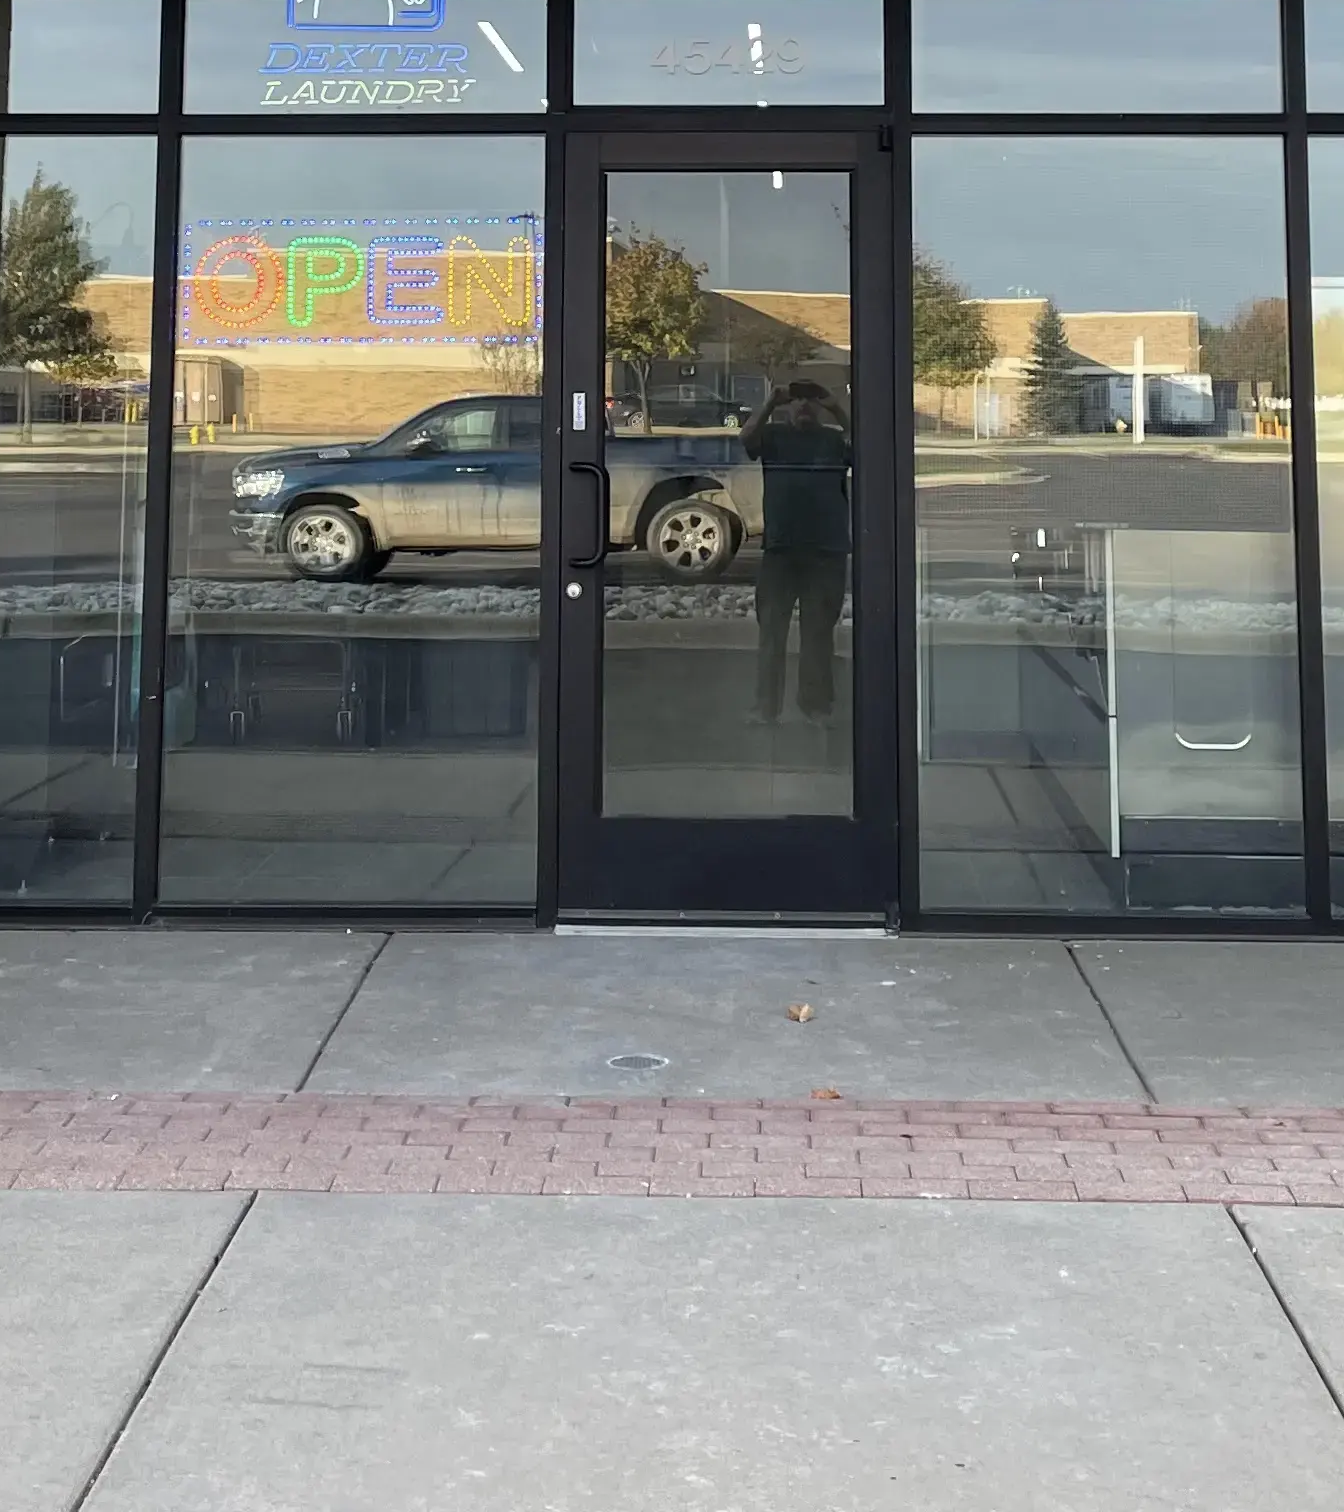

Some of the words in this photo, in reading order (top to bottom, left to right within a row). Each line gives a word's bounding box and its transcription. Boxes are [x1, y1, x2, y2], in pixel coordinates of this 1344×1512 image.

[258, 41, 469, 74] DEXTER
[260, 79, 477, 105] LAUNDRY
[193, 235, 533, 328] OPEN
